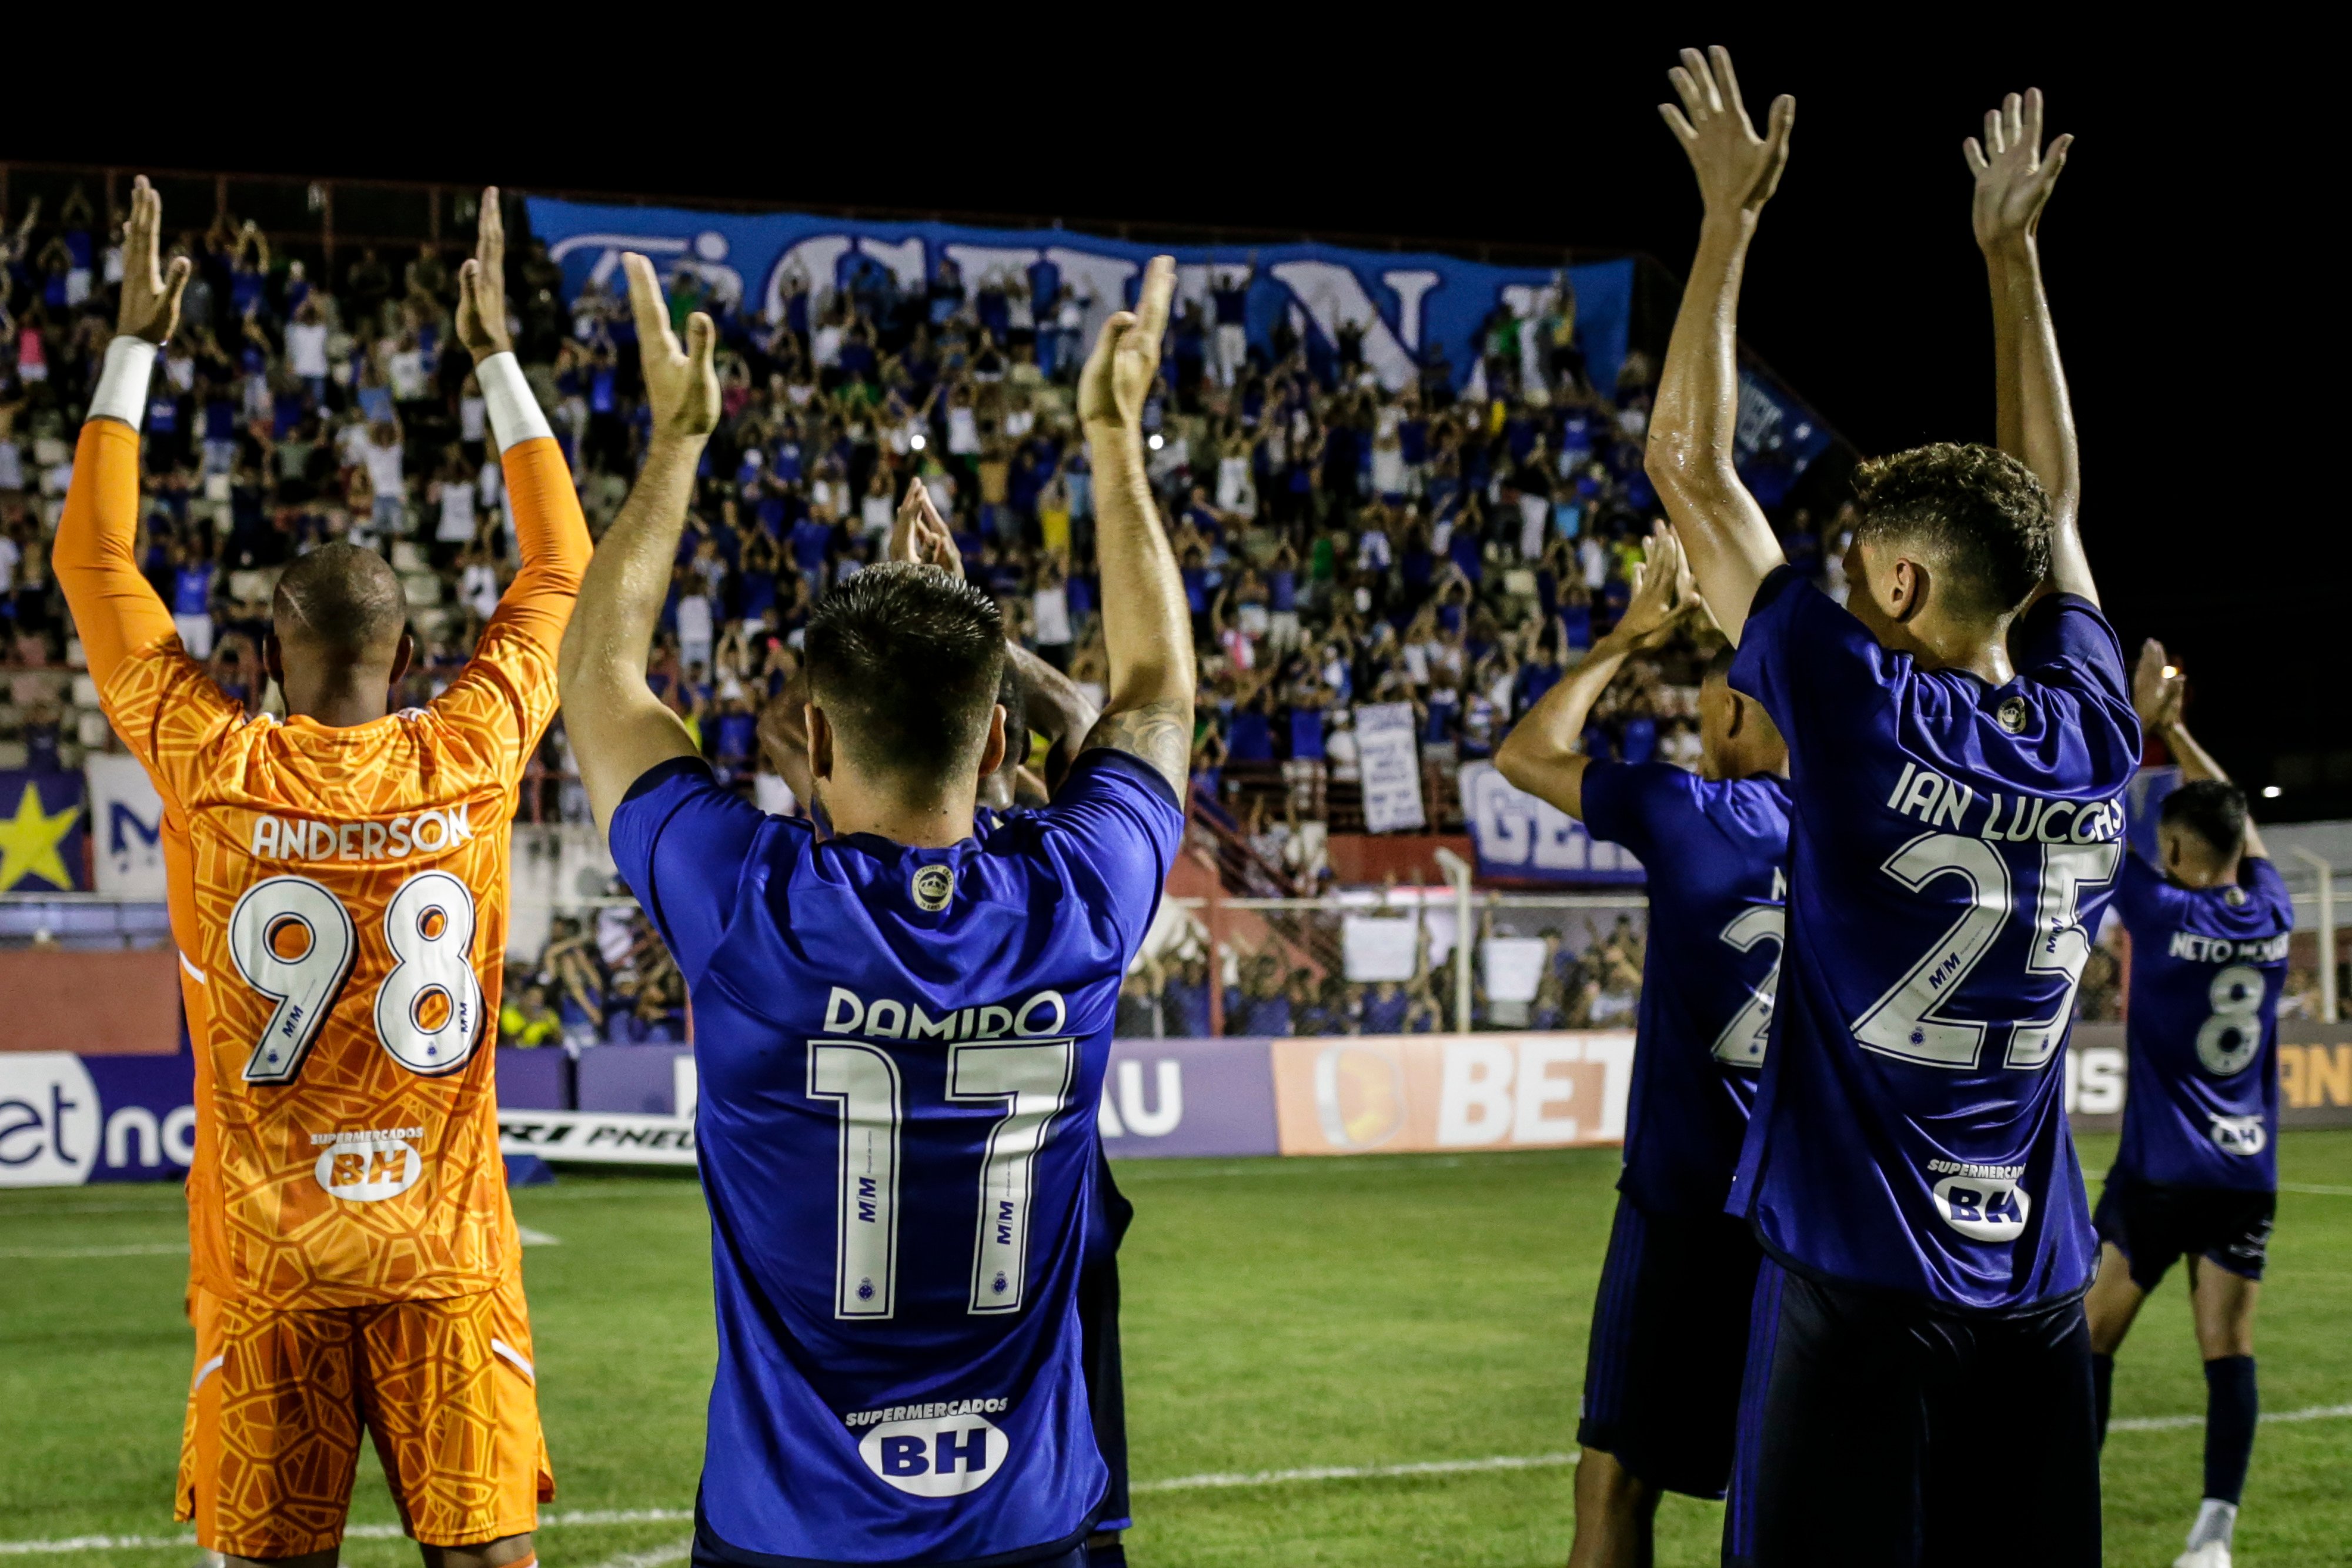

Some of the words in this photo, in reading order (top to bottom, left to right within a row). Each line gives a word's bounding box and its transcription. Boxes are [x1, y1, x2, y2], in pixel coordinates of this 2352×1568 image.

[1887, 762, 1972, 830] IAN
[251, 803, 473, 861] ANDERSON
[1850, 829, 2122, 1069] 25
[2169, 931, 2233, 963] NETO
[228, 870, 481, 1082] 98
[2196, 965, 2266, 1076] 8
[310, 1127, 423, 1145] SUPERMERCADOS
[330, 1149, 407, 1187] BH
[806, 1037, 1075, 1319] 17
[1948, 1185, 2023, 1223] BH
[846, 1398, 1008, 1427] SUPERMERCADOS
[881, 1427, 987, 1477] BH
